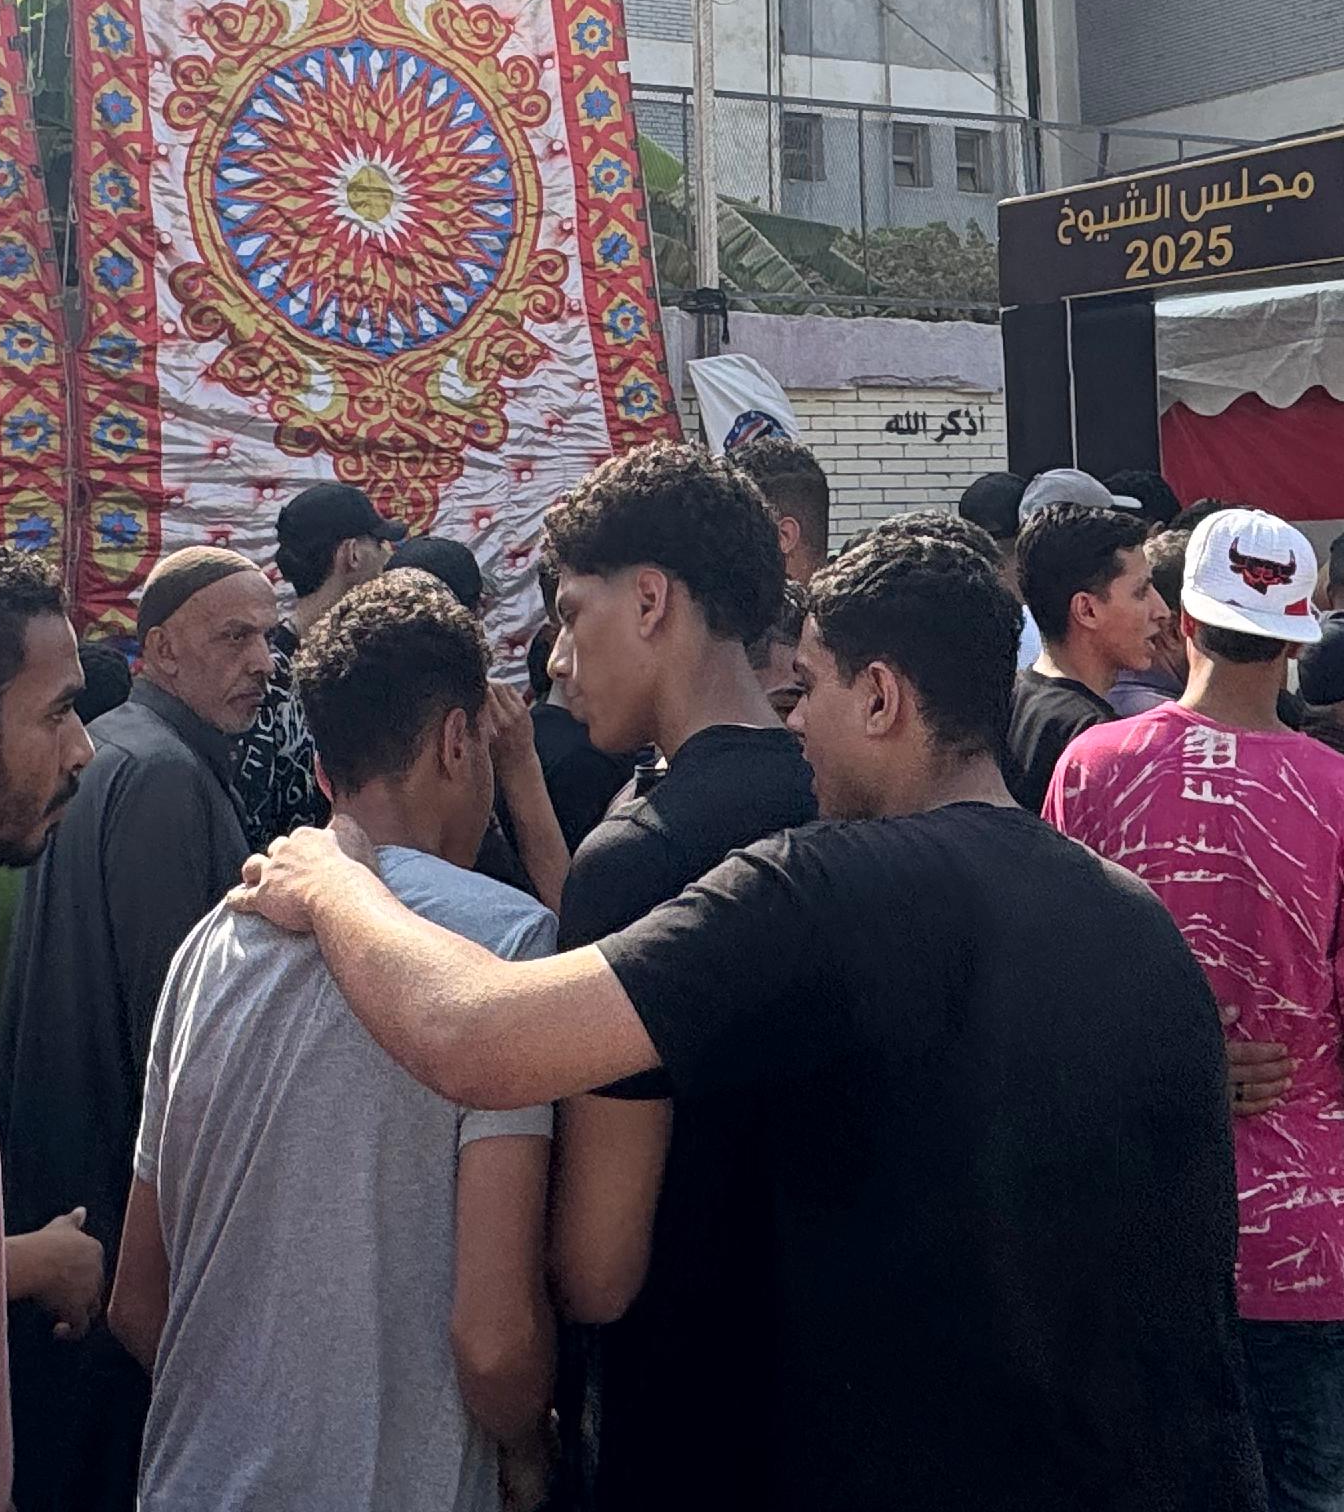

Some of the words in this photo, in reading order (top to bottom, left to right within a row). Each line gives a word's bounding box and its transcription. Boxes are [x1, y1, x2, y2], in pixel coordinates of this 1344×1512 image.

[1057, 183, 1171, 245] الشيوخ
[1180, 167, 1315, 222] مجلس
[1125, 225, 1234, 280] 2025
[885, 411, 927, 435] الله
